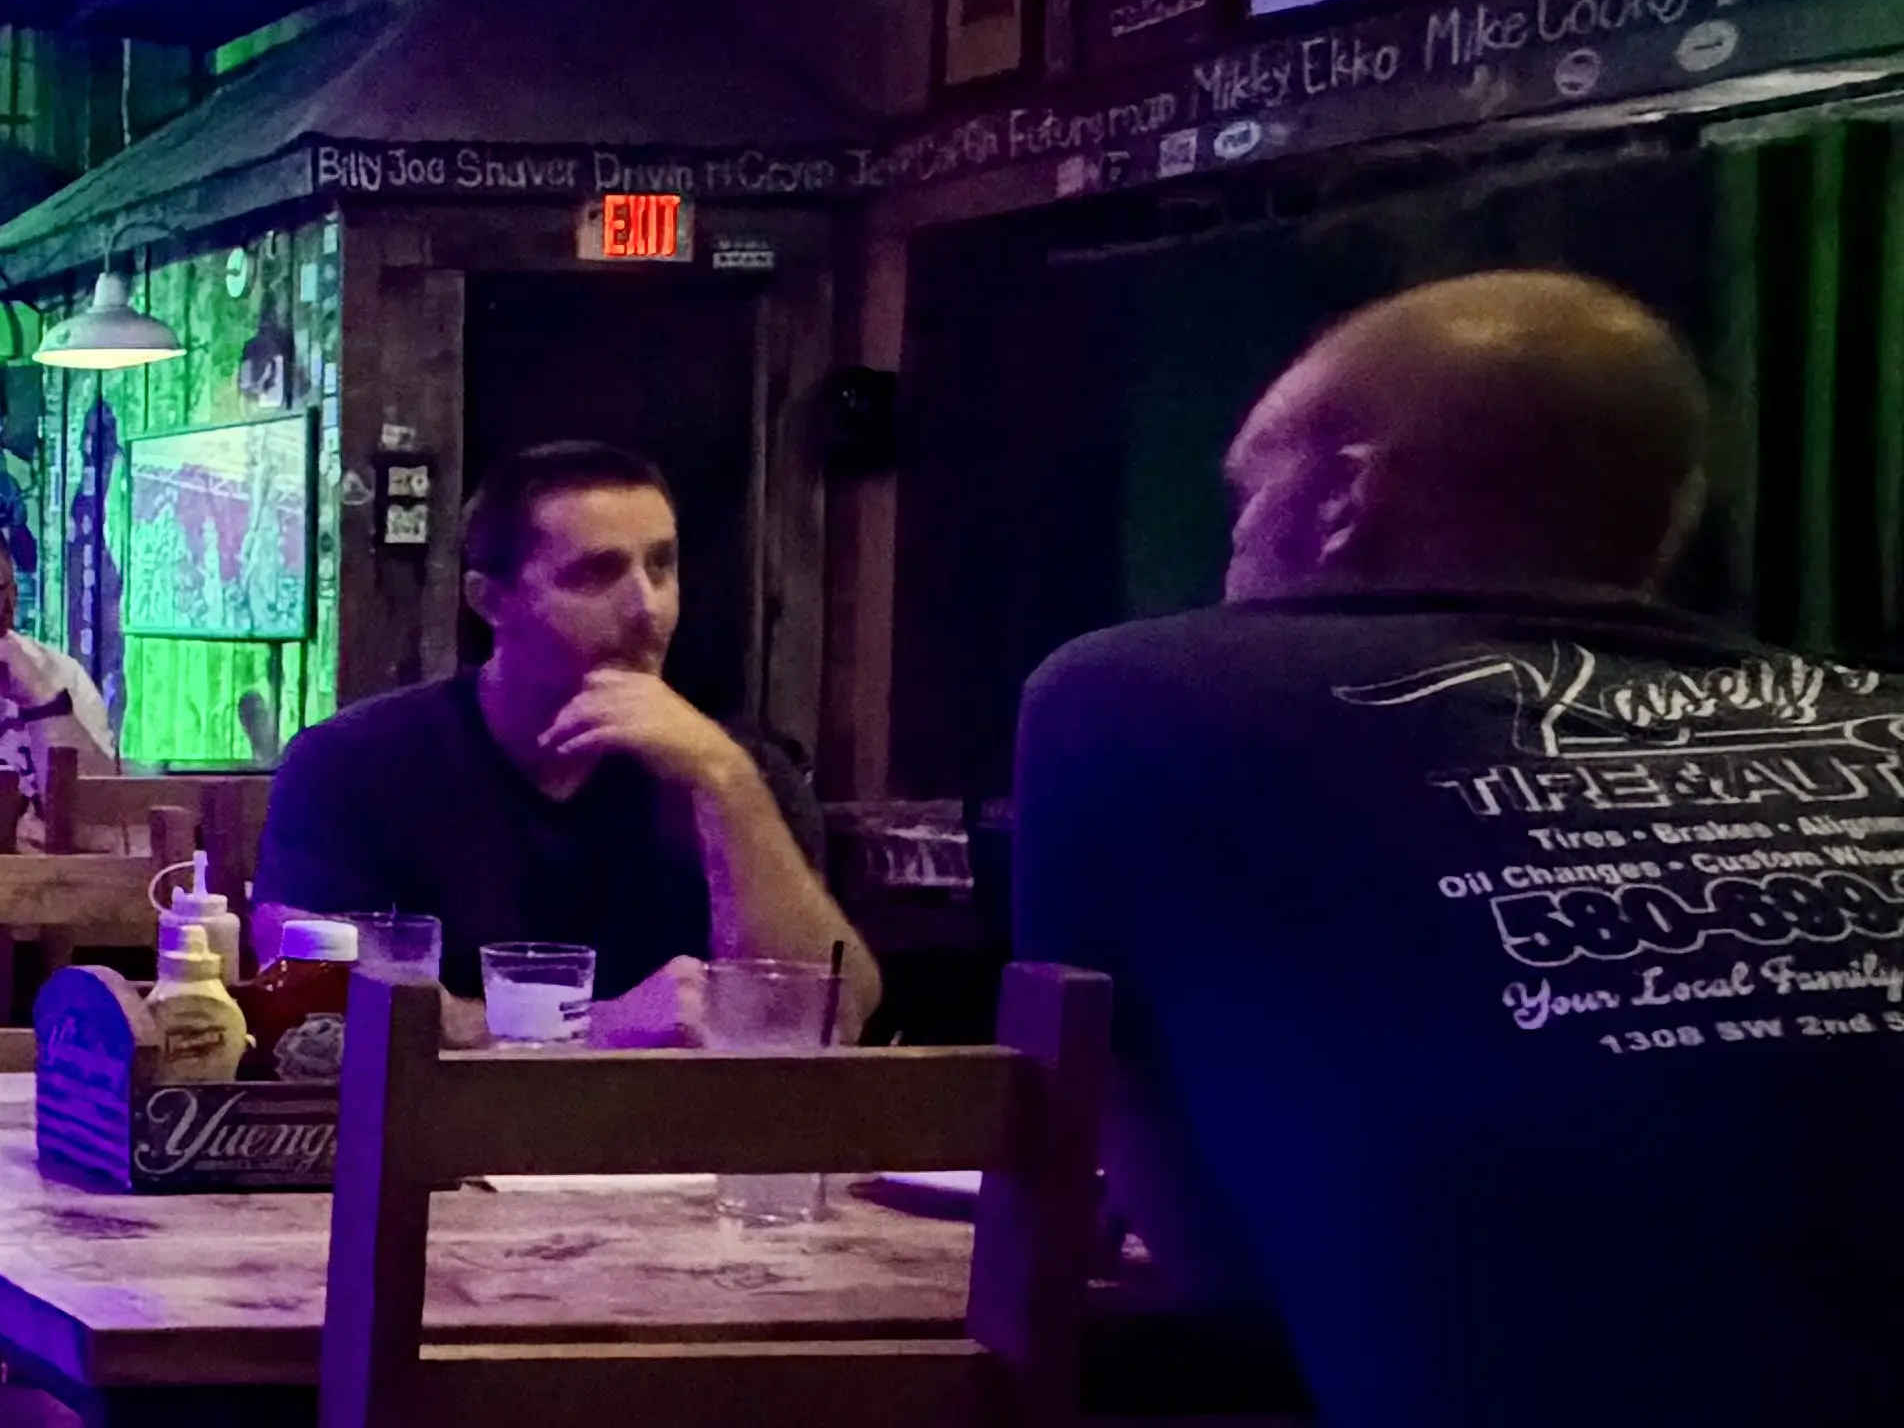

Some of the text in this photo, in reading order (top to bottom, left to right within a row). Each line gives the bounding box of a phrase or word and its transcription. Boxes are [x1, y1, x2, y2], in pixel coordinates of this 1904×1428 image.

[317, 145, 382, 193] Billy
[1303, 34, 1401, 96] Ekko
[1424, 0, 1529, 72] Mike
[602, 192, 682, 258] EXIT
[1428, 759, 1674, 817] TIRE
[1527, 824, 1628, 853] Tires
[1650, 819, 1777, 846] Brakes
[1436, 869, 1496, 900] Oil
[1500, 857, 1663, 890] Changes
[1690, 847, 1827, 875] Custom
[1500, 974, 1623, 1032] Your
[1628, 960, 1756, 1008] Local
[1713, 1016, 1787, 1044] SW
[1795, 1009, 1879, 1038] 2nd
